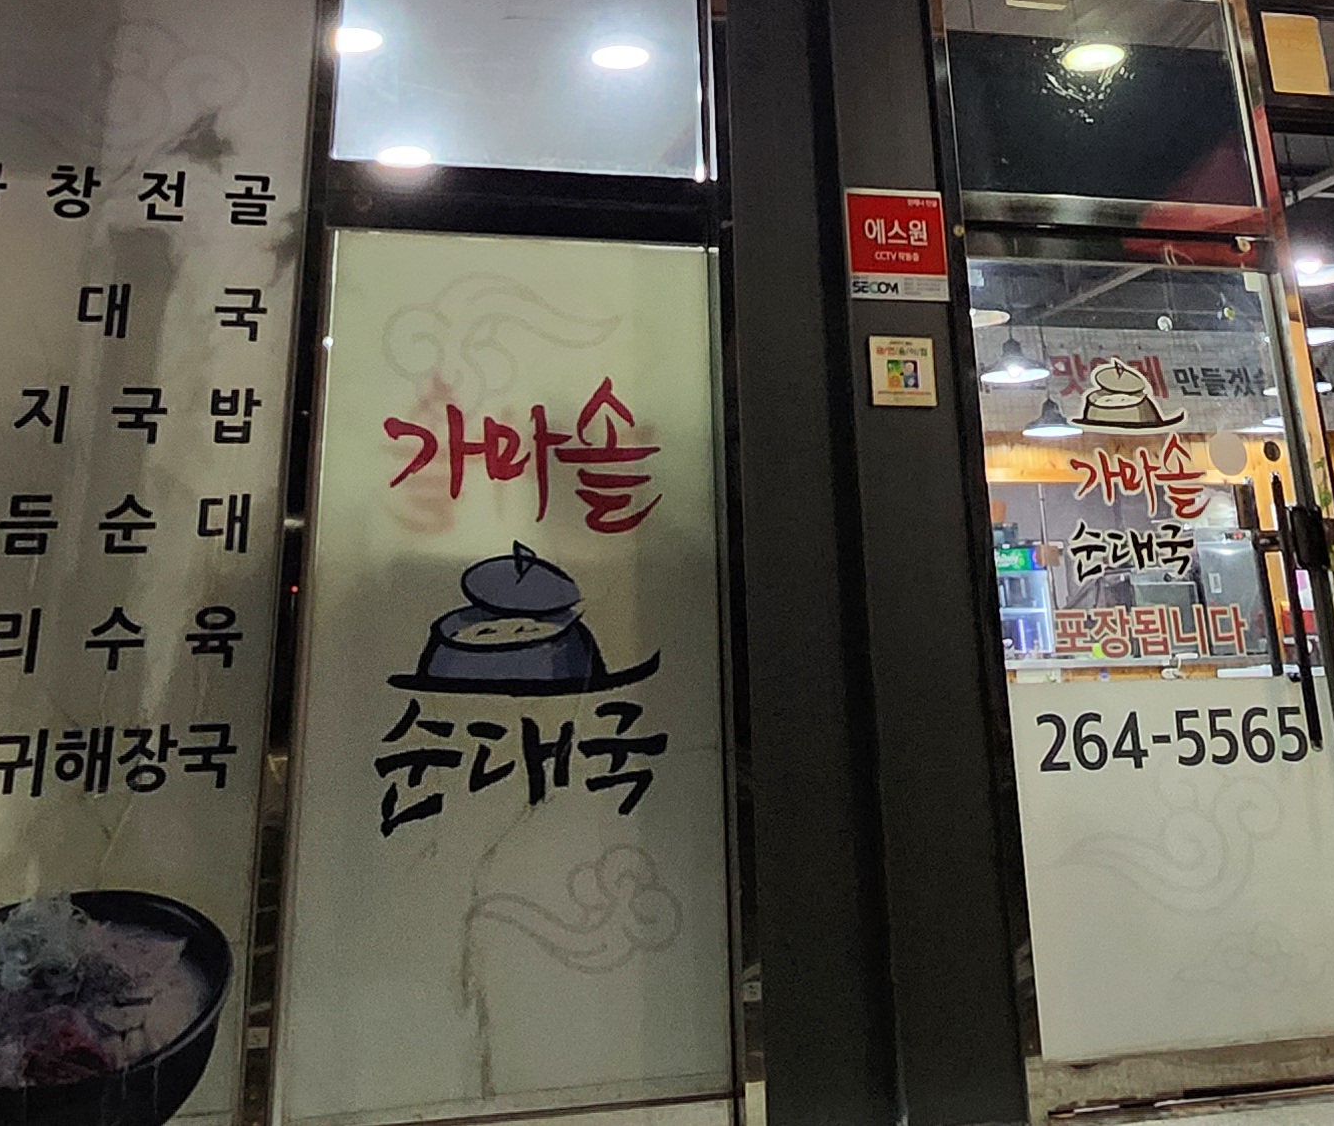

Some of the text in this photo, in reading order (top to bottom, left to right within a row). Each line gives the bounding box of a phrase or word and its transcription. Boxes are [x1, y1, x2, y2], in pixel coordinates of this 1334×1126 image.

[864, 218, 928, 247] 에스원
[874, 251, 897, 262] CCTV
[852, 280, 899, 295] SECOM
[1050, 354, 1169, 399] 맛게
[384, 377, 663, 534] 가마솥
[1070, 434, 1210, 520] 가마솥
[1070, 521, 1194, 582] 순대국
[1054, 603, 1246, 659] 포장됩니다
[1035, 704, 1308, 773] 264-5565
[374, 699, 668, 838] 순대국
